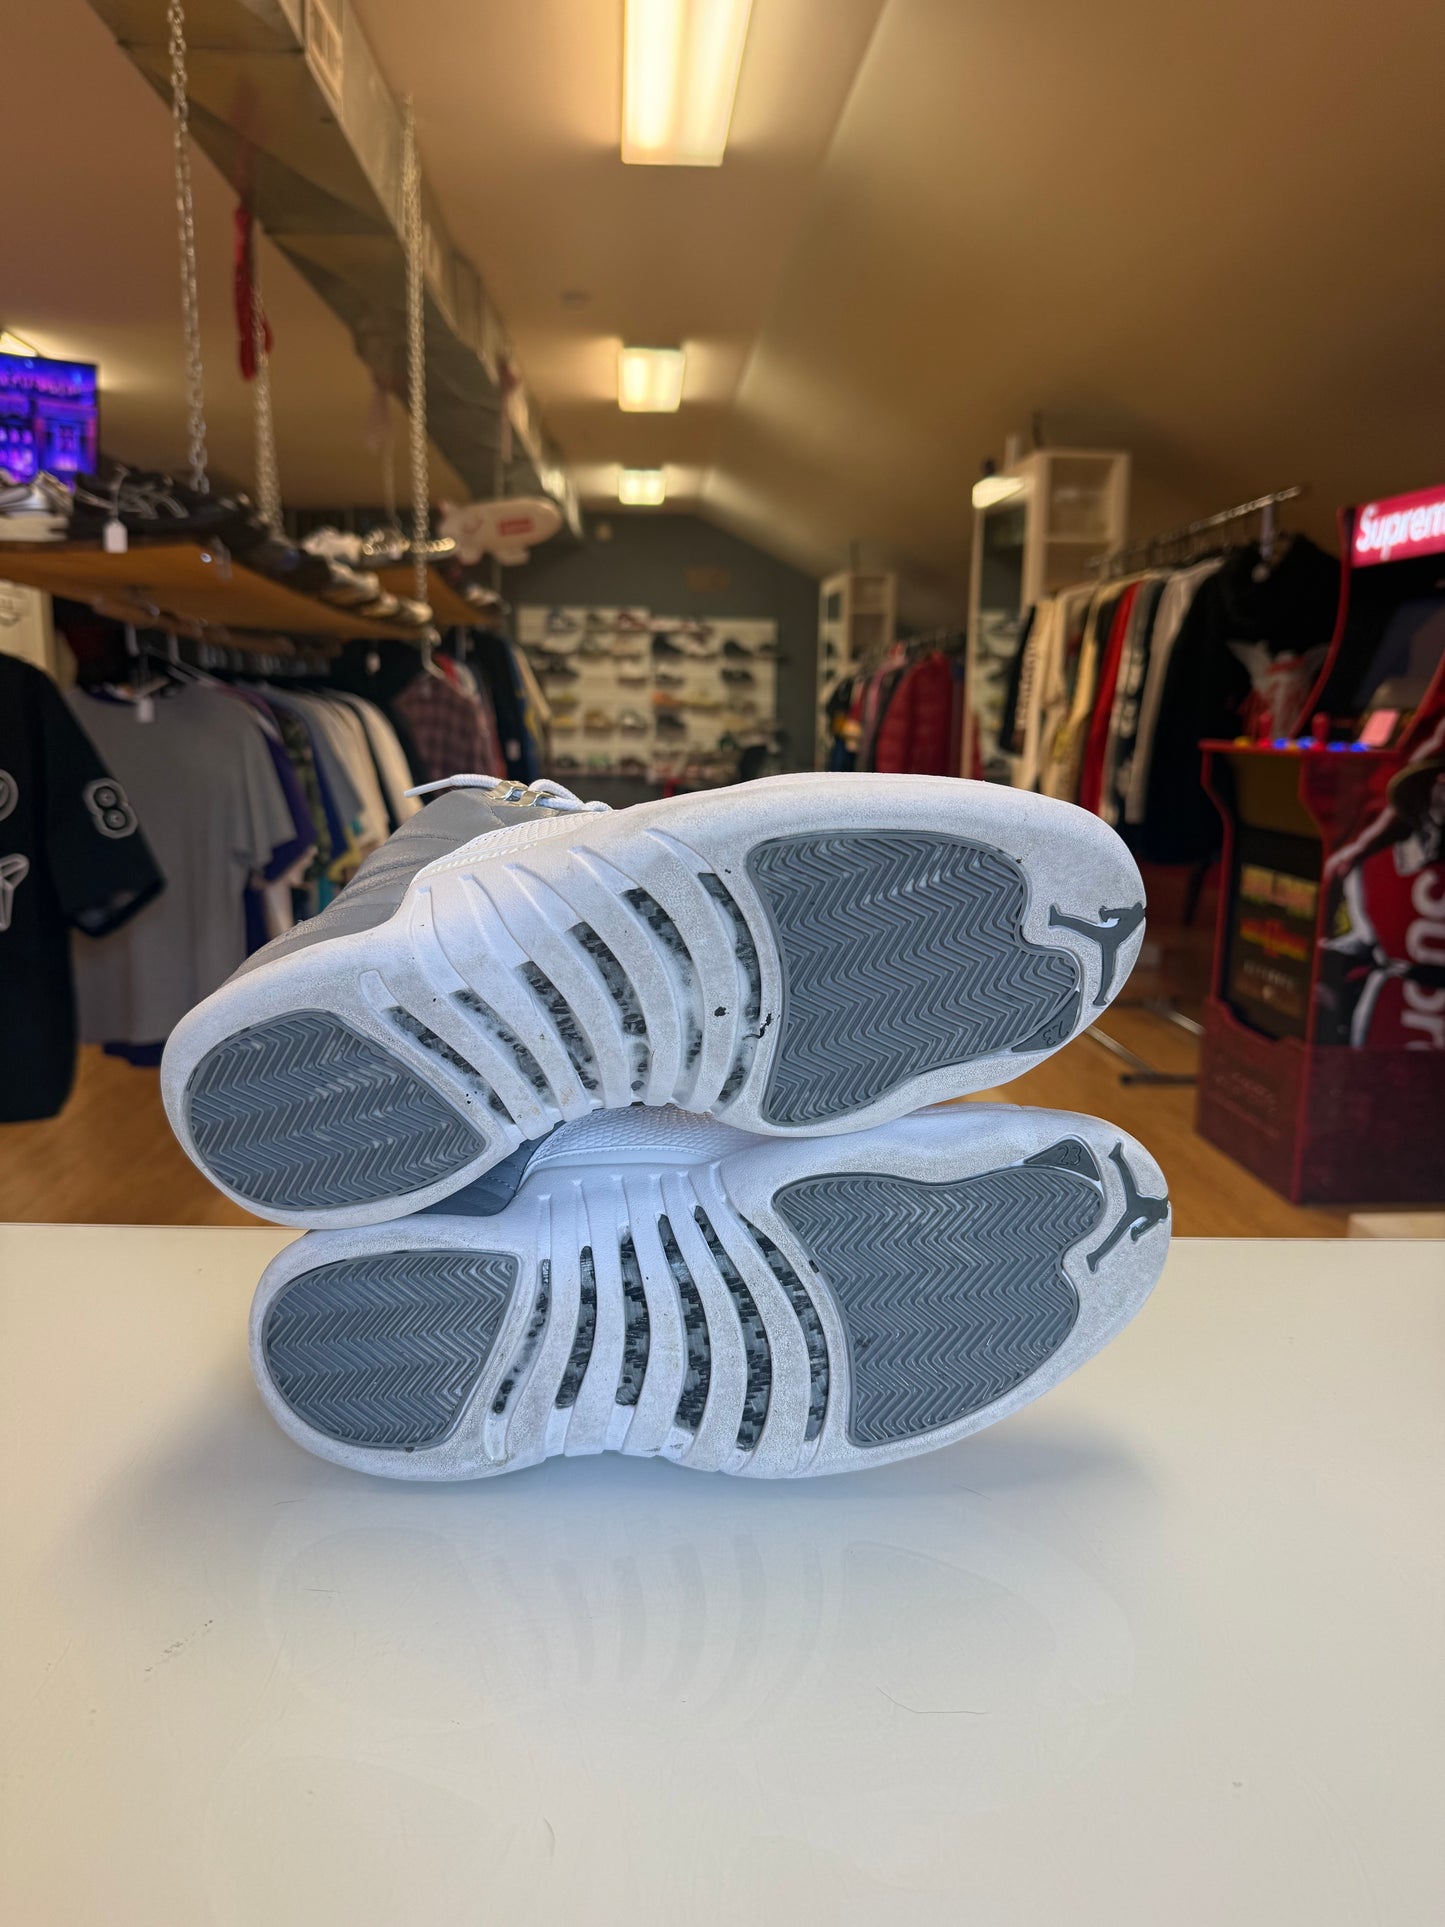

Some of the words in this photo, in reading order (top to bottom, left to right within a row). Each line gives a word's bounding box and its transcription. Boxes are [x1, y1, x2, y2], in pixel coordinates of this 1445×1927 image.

[82, 777, 139, 839] 8
[1042, 1020, 1070, 1047] 23
[1055, 1144, 1082, 1166] 23
